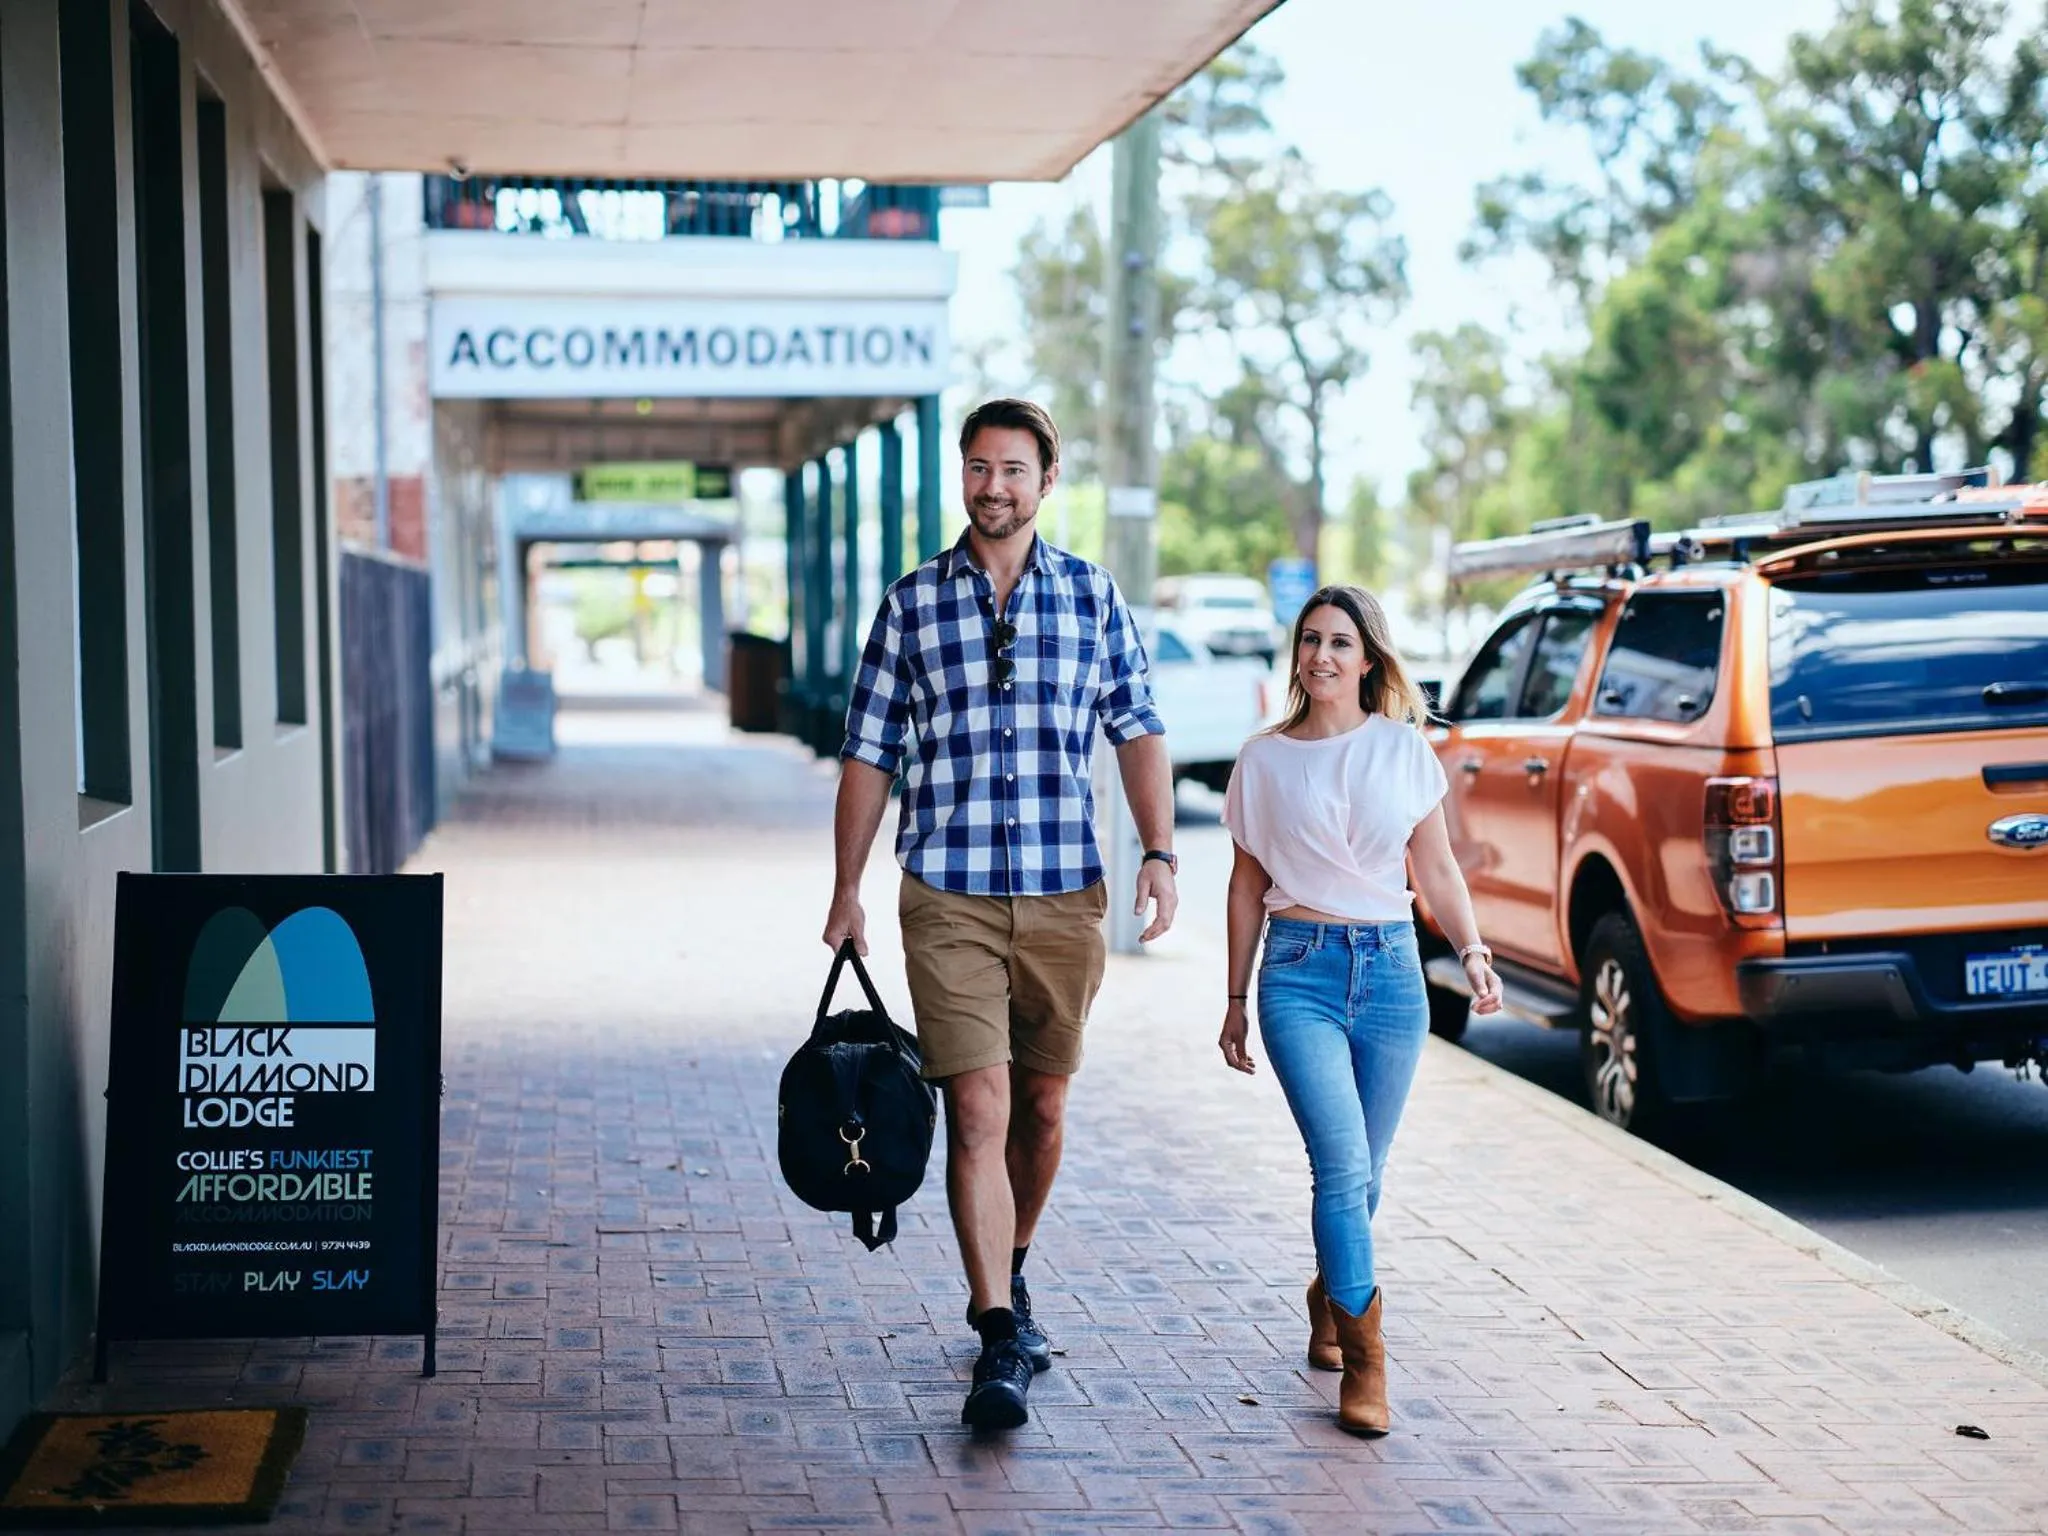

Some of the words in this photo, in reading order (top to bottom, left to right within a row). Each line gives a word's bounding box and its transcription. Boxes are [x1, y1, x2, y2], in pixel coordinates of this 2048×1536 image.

[449, 326, 934, 368] ACCOMMODATION
[187, 1028, 293, 1057] BLACK
[185, 1063, 369, 1092] DIAMOND
[184, 1097, 294, 1128] LODGE
[176, 1150, 264, 1170] COLLIE'S
[270, 1150, 373, 1169] FUNKIEST
[175, 1173, 373, 1202] AFFORDABLE
[175, 1204, 372, 1223] ACCOMMODATION
[173, 1272, 232, 1294] STAY
[244, 1271, 301, 1291] PLAY
[312, 1269, 370, 1290] SLAY
